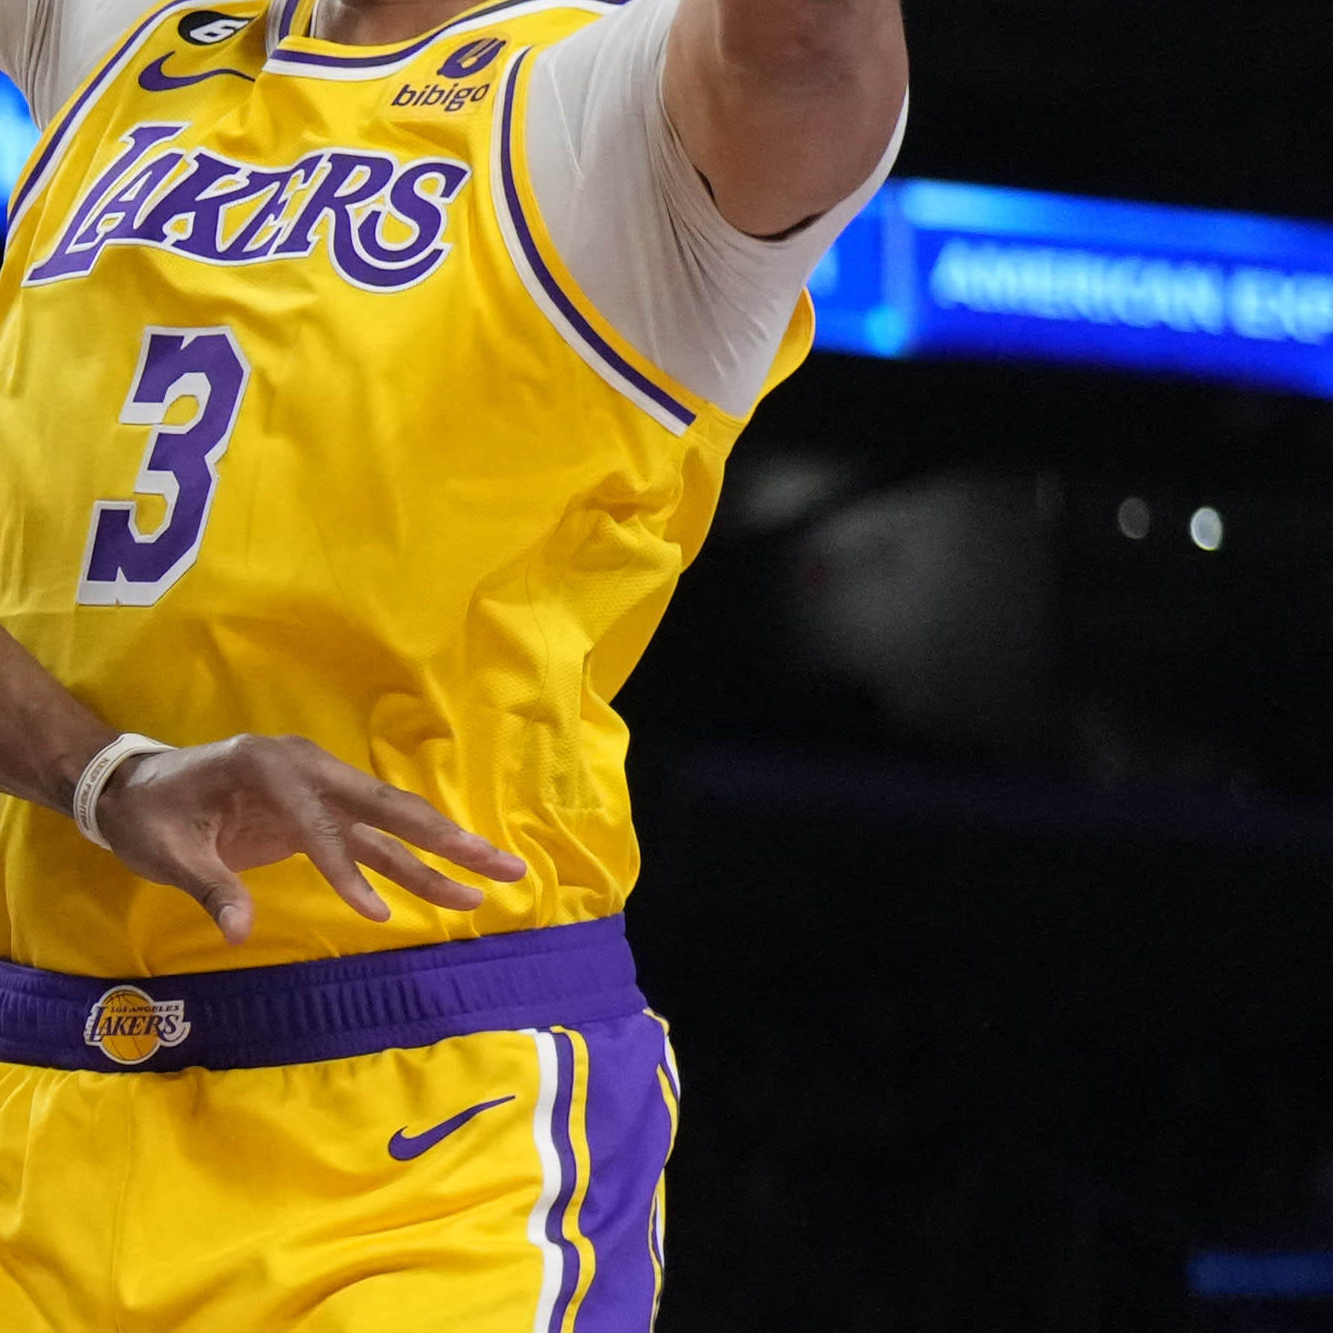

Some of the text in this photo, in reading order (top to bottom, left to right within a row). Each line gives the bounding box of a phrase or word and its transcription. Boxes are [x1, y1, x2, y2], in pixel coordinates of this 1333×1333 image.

[390, 82, 491, 112] bibigo
[21, 122, 472, 293] LAKERS
[75, 324, 253, 606] 3
[89, 1006, 188, 1044] LAKERS
